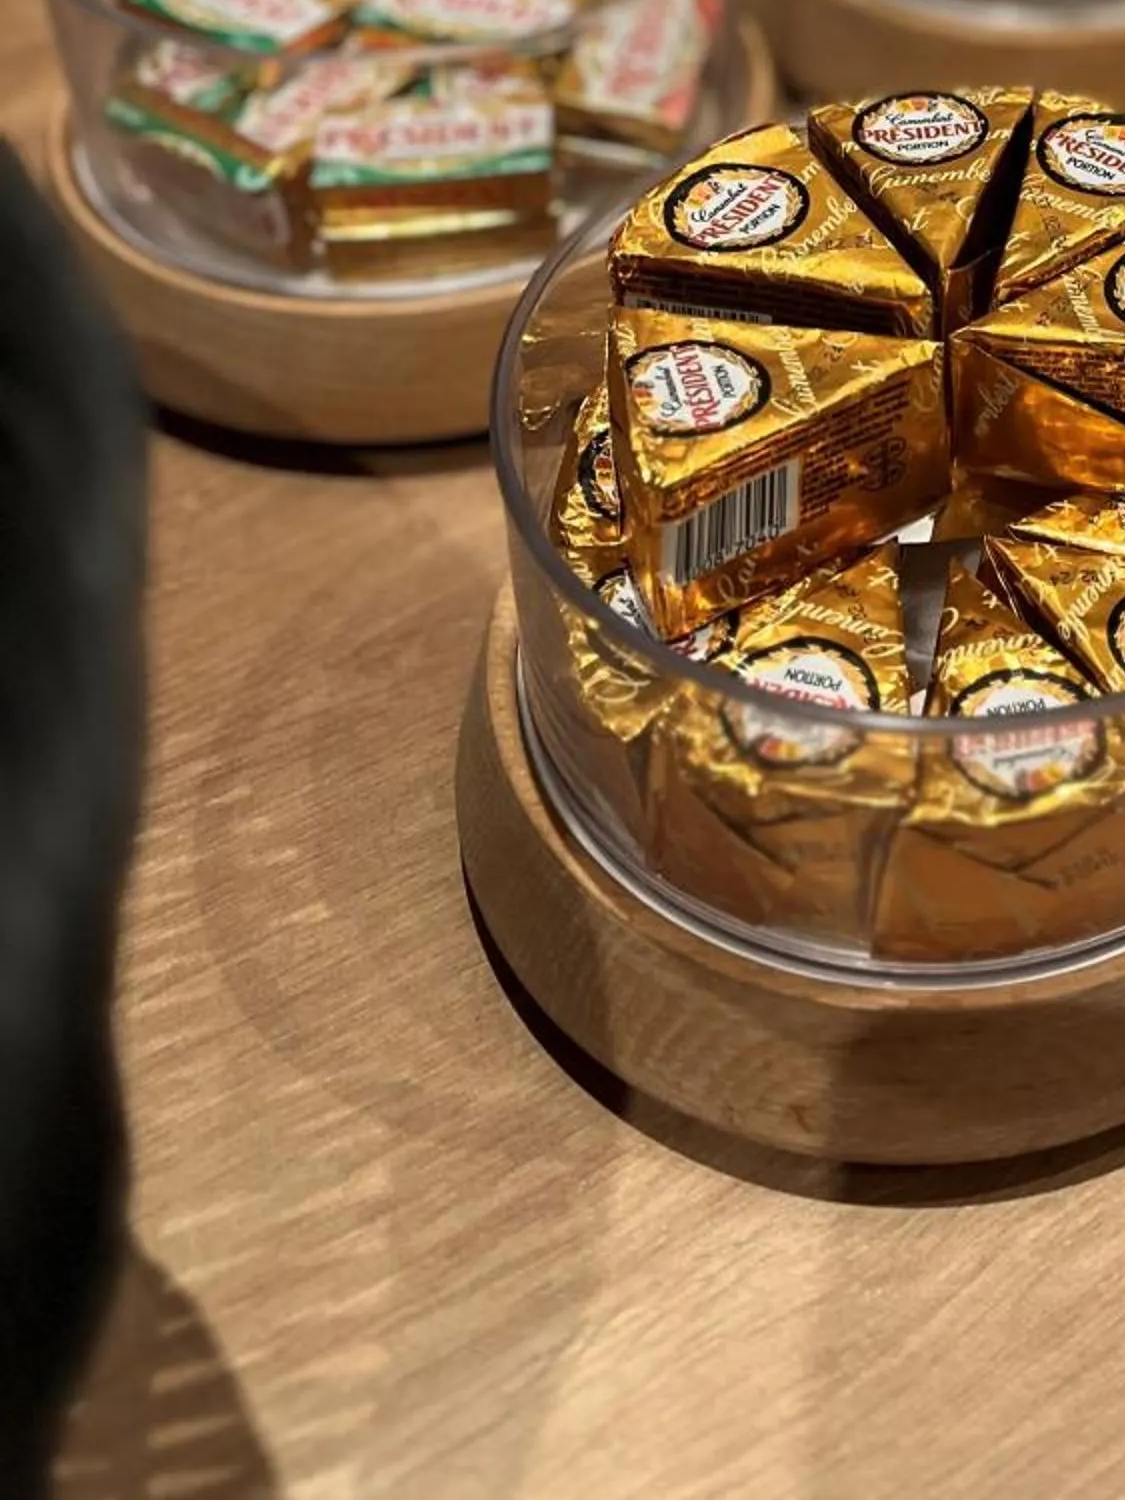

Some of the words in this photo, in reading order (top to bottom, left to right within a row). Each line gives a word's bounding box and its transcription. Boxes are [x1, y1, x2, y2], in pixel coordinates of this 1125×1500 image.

[897, 140, 949, 151] PORTION
[1066, 157, 1116, 180] PORTION
[739, 203, 781, 234] PORTION
[785, 667, 843, 692] PORTION
